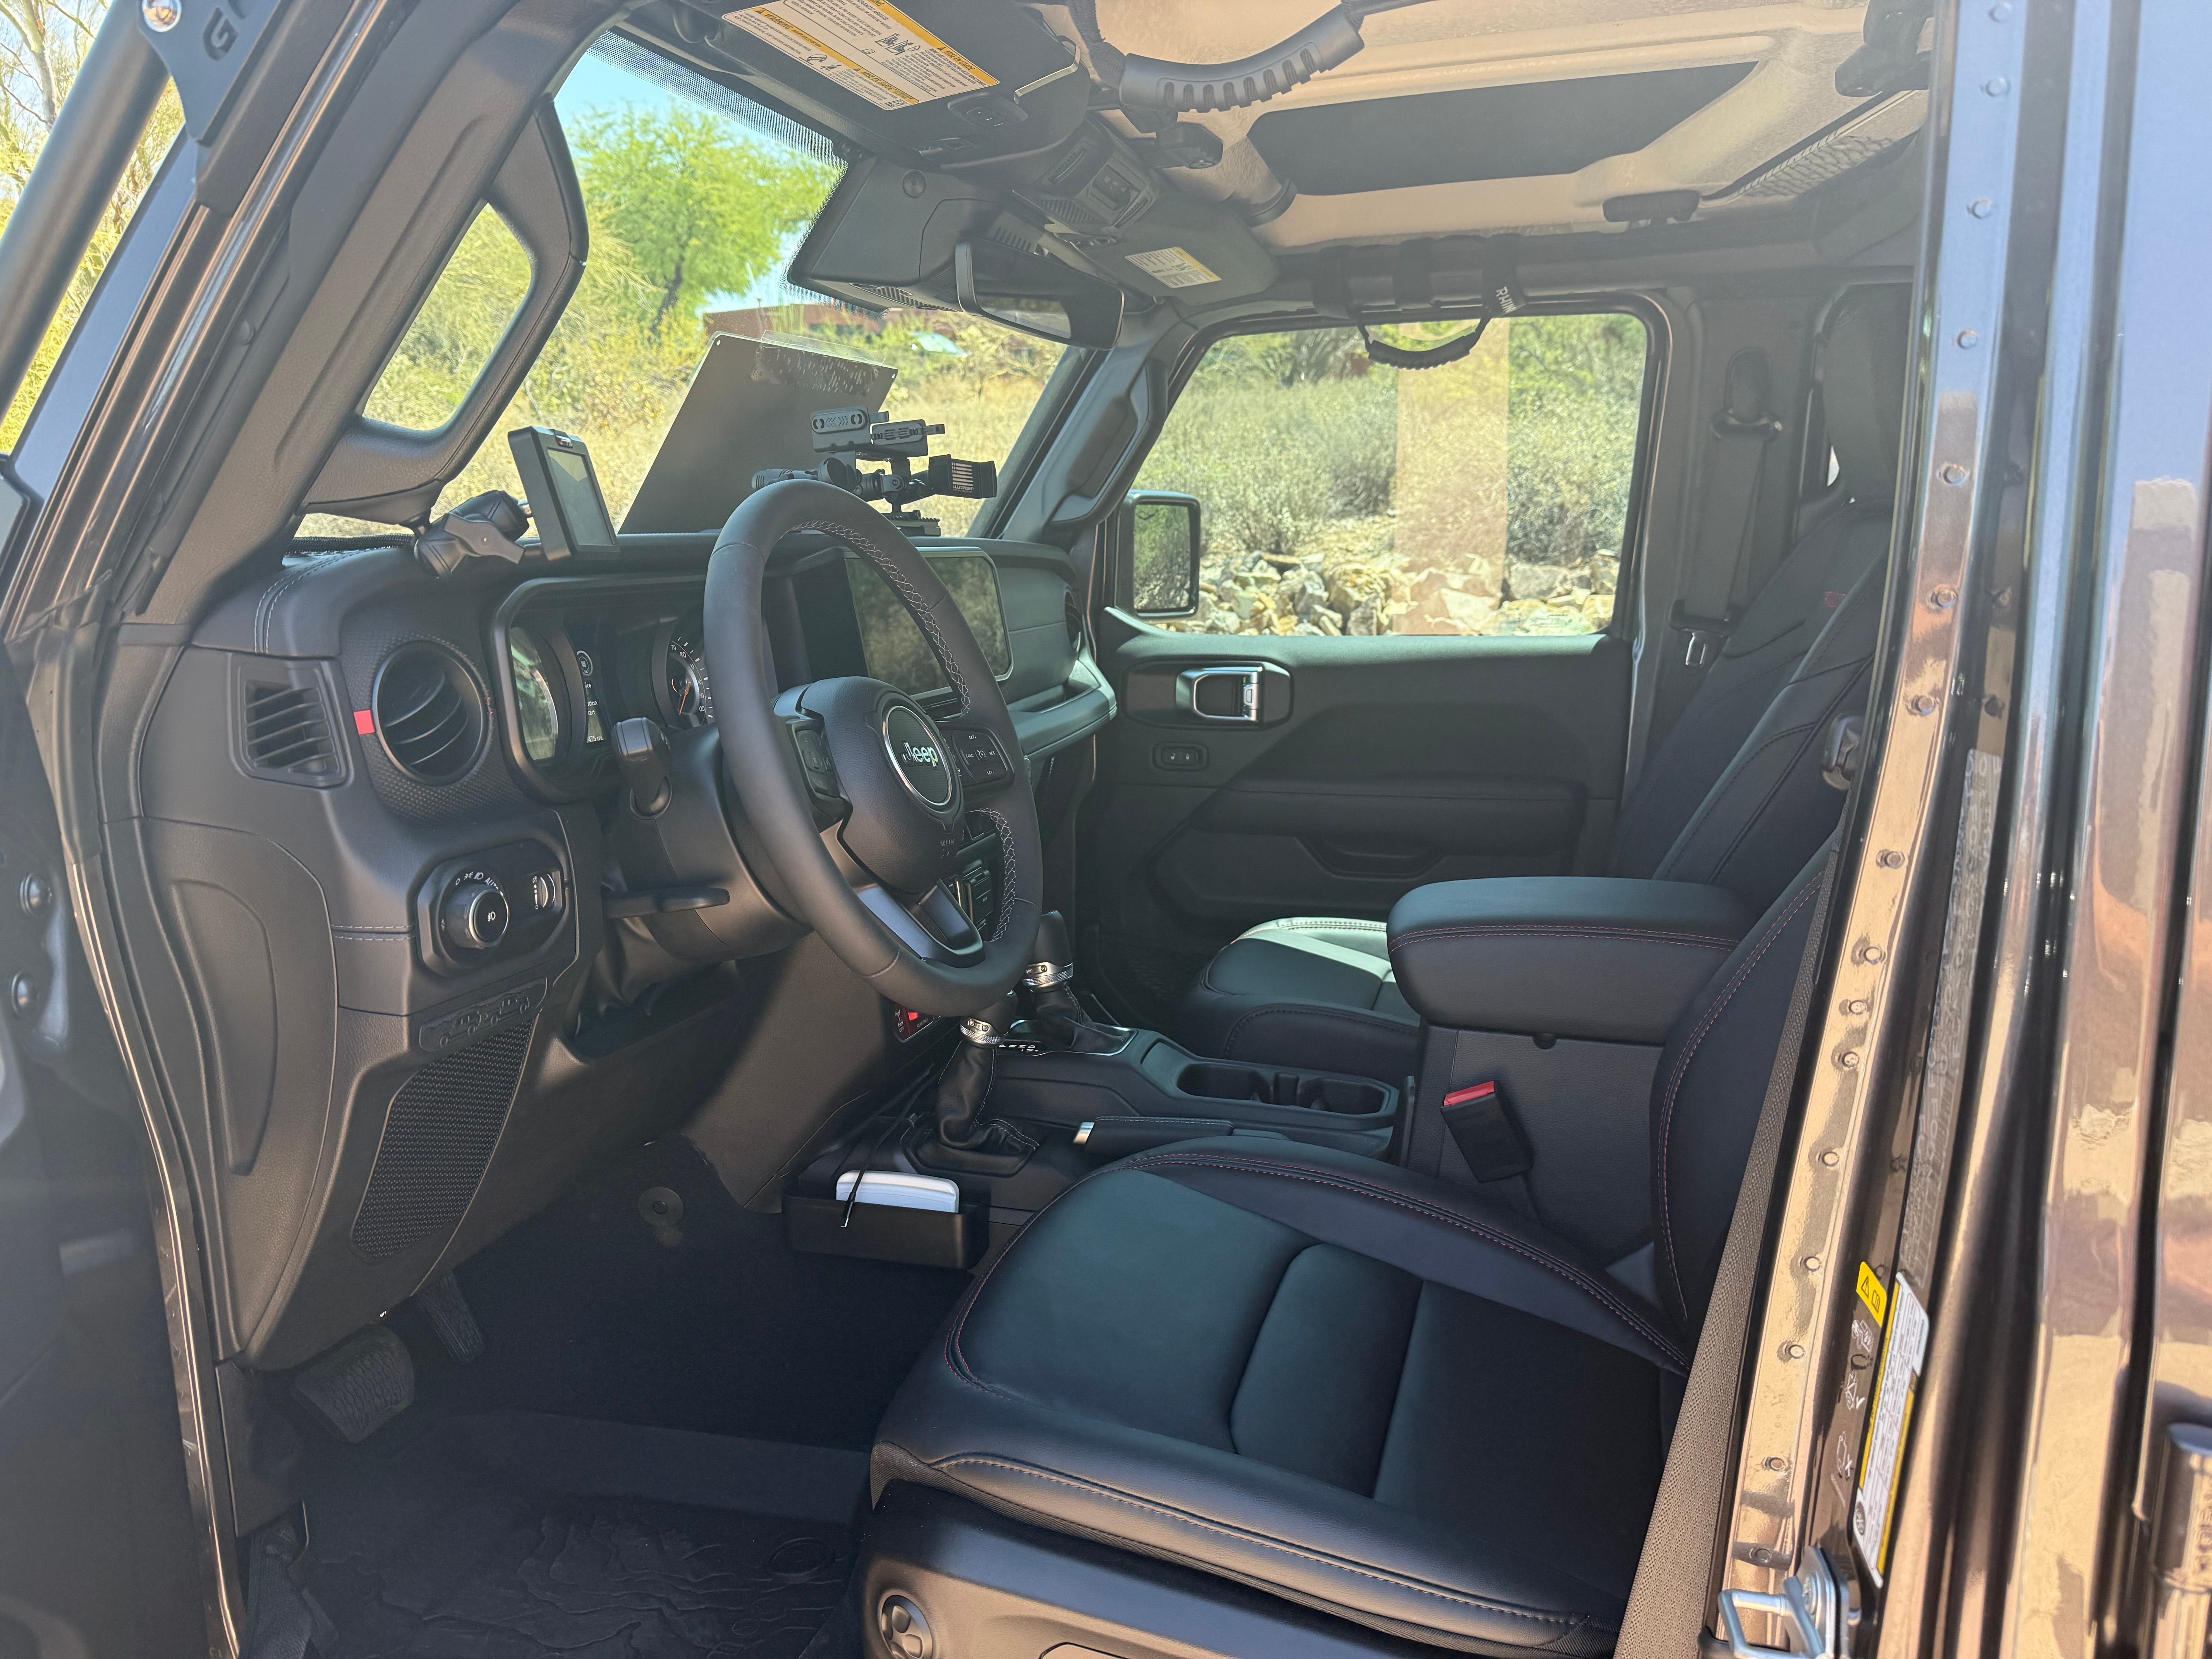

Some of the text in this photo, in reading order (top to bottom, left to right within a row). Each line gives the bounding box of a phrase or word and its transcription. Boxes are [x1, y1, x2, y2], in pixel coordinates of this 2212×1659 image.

[763, 13, 794, 29] WARNING
[958, 61, 975, 70] GARDE
[901, 741, 938, 767] Jeep
